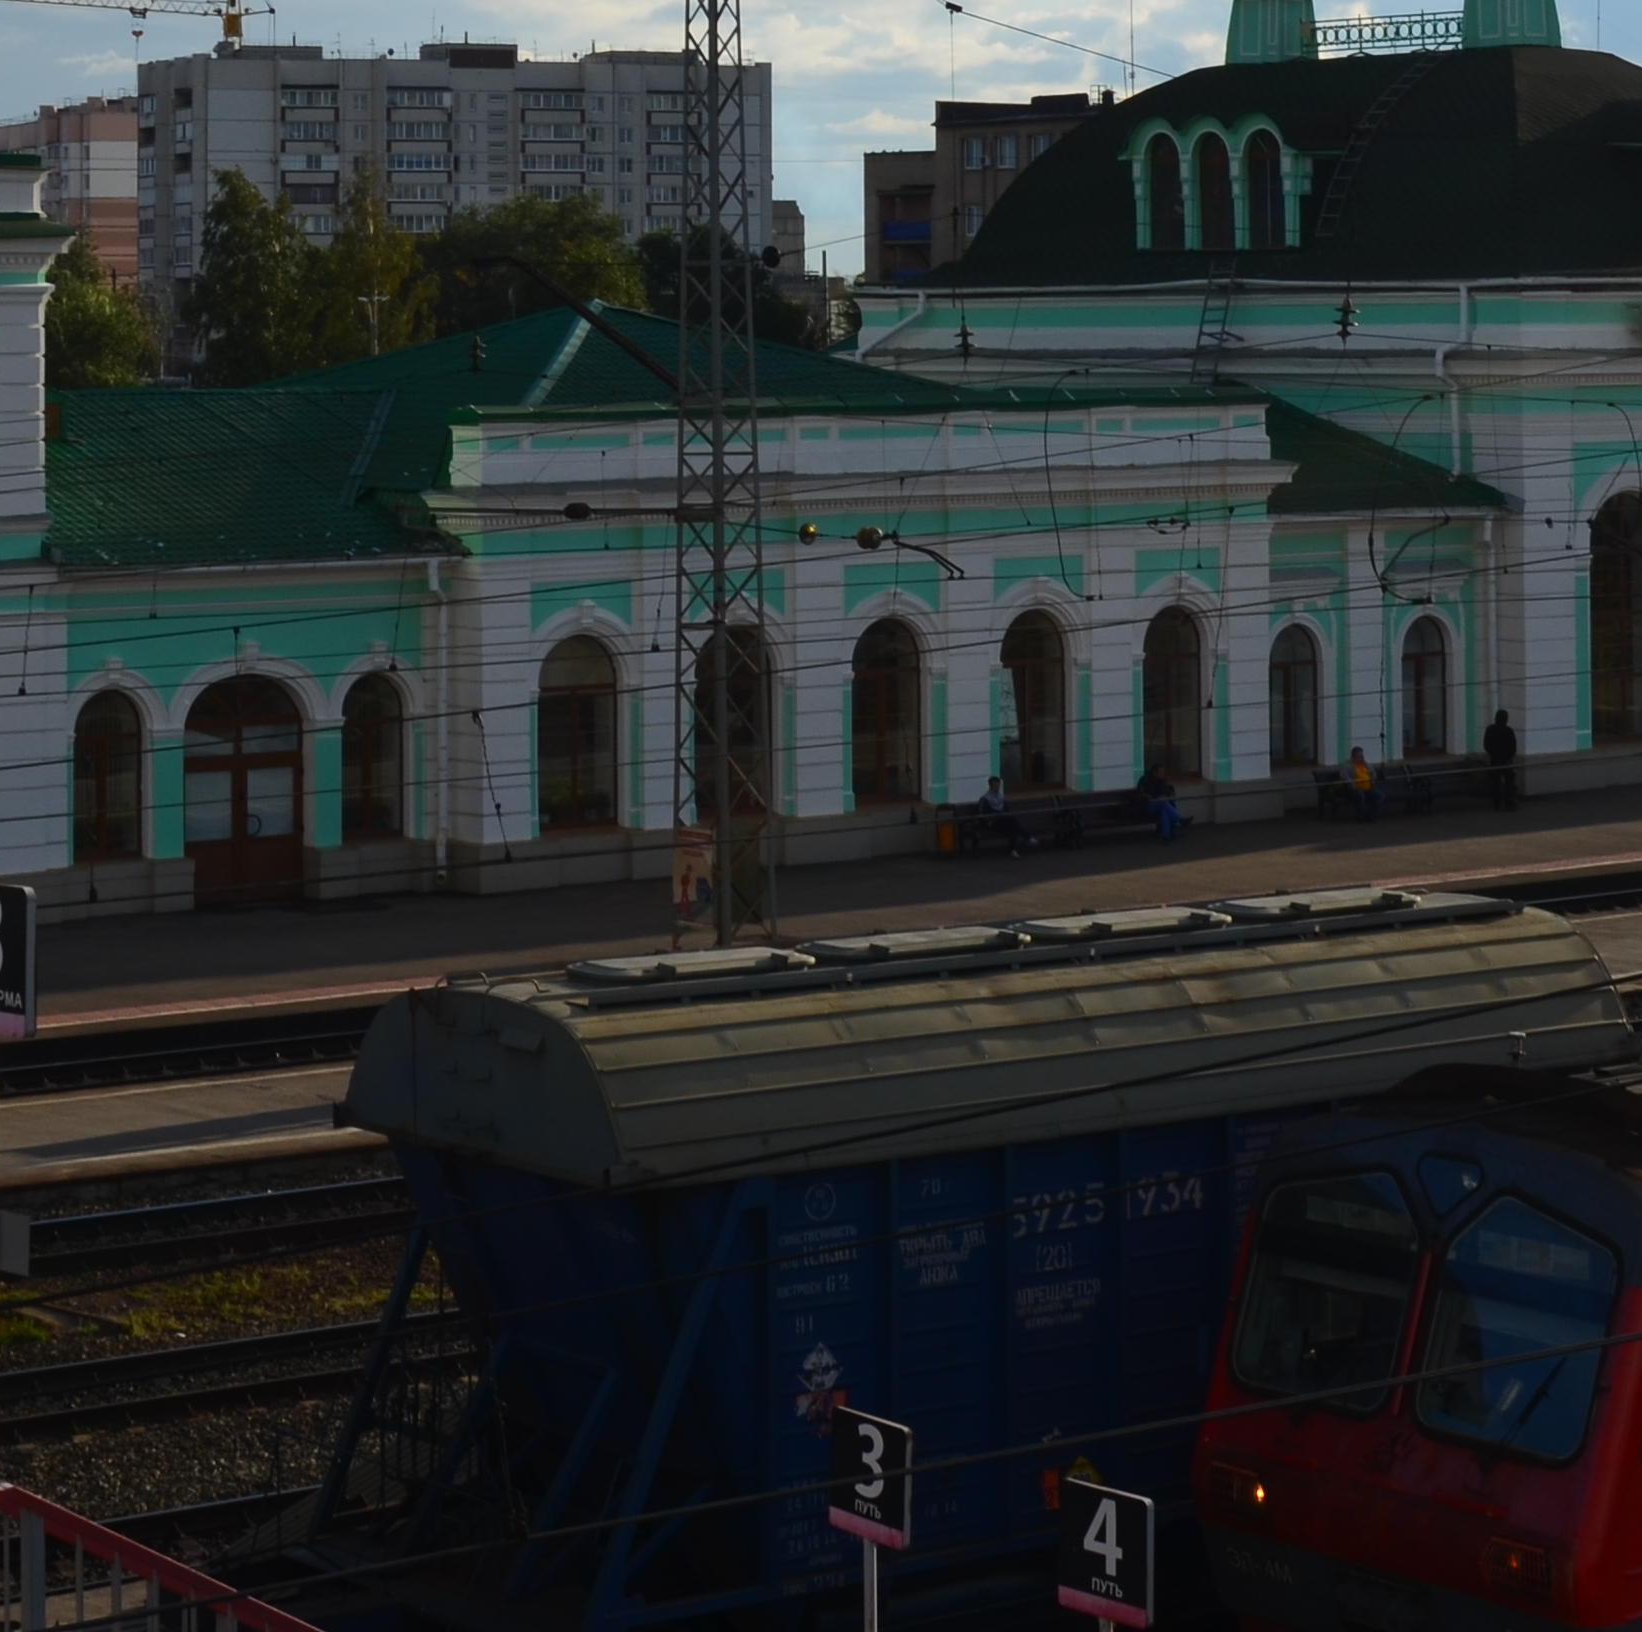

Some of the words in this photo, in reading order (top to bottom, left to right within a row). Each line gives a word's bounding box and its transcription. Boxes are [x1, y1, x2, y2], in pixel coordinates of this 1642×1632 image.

[854, 1422, 885, 1500] 3
[854, 1498, 882, 1520] ПУТЬ
[1083, 1496, 1124, 1578] 4
[1091, 1575, 1124, 1599] ПУТЬ
